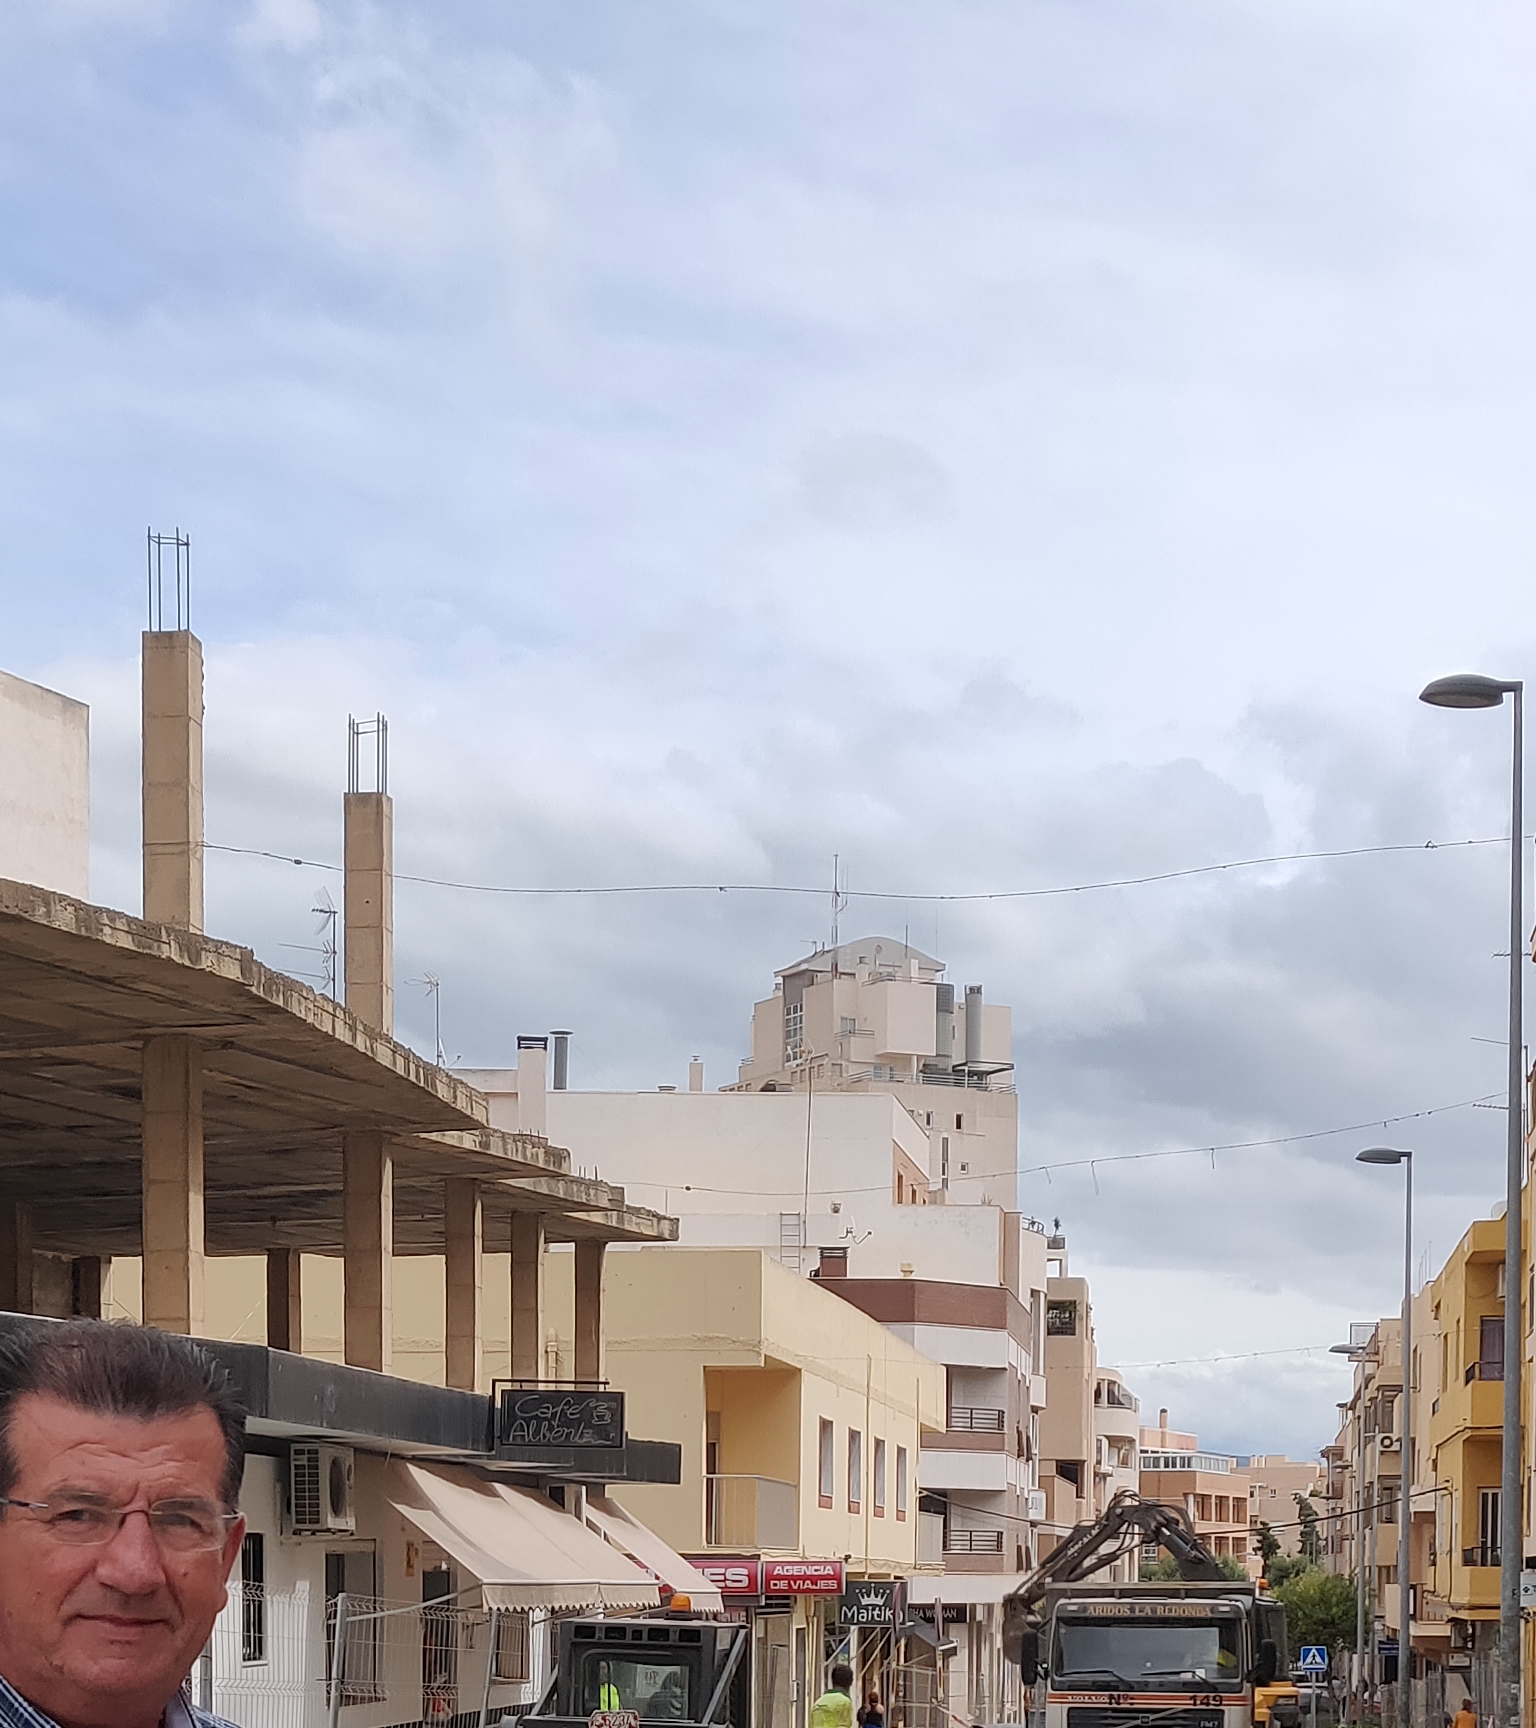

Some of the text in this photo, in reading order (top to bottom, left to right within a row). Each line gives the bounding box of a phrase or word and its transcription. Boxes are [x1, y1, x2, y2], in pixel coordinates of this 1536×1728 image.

[773, 1565, 834, 1576] AGENCIA
[695, 1567, 749, 1588] ES
[770, 1579, 838, 1590] DE VIAJES
[1087, 1605, 1212, 1617] ARIDOS LA REDONDA
[1189, 1694, 1223, 1707] 149
[1200, 1721, 1219, 1728] FM7
